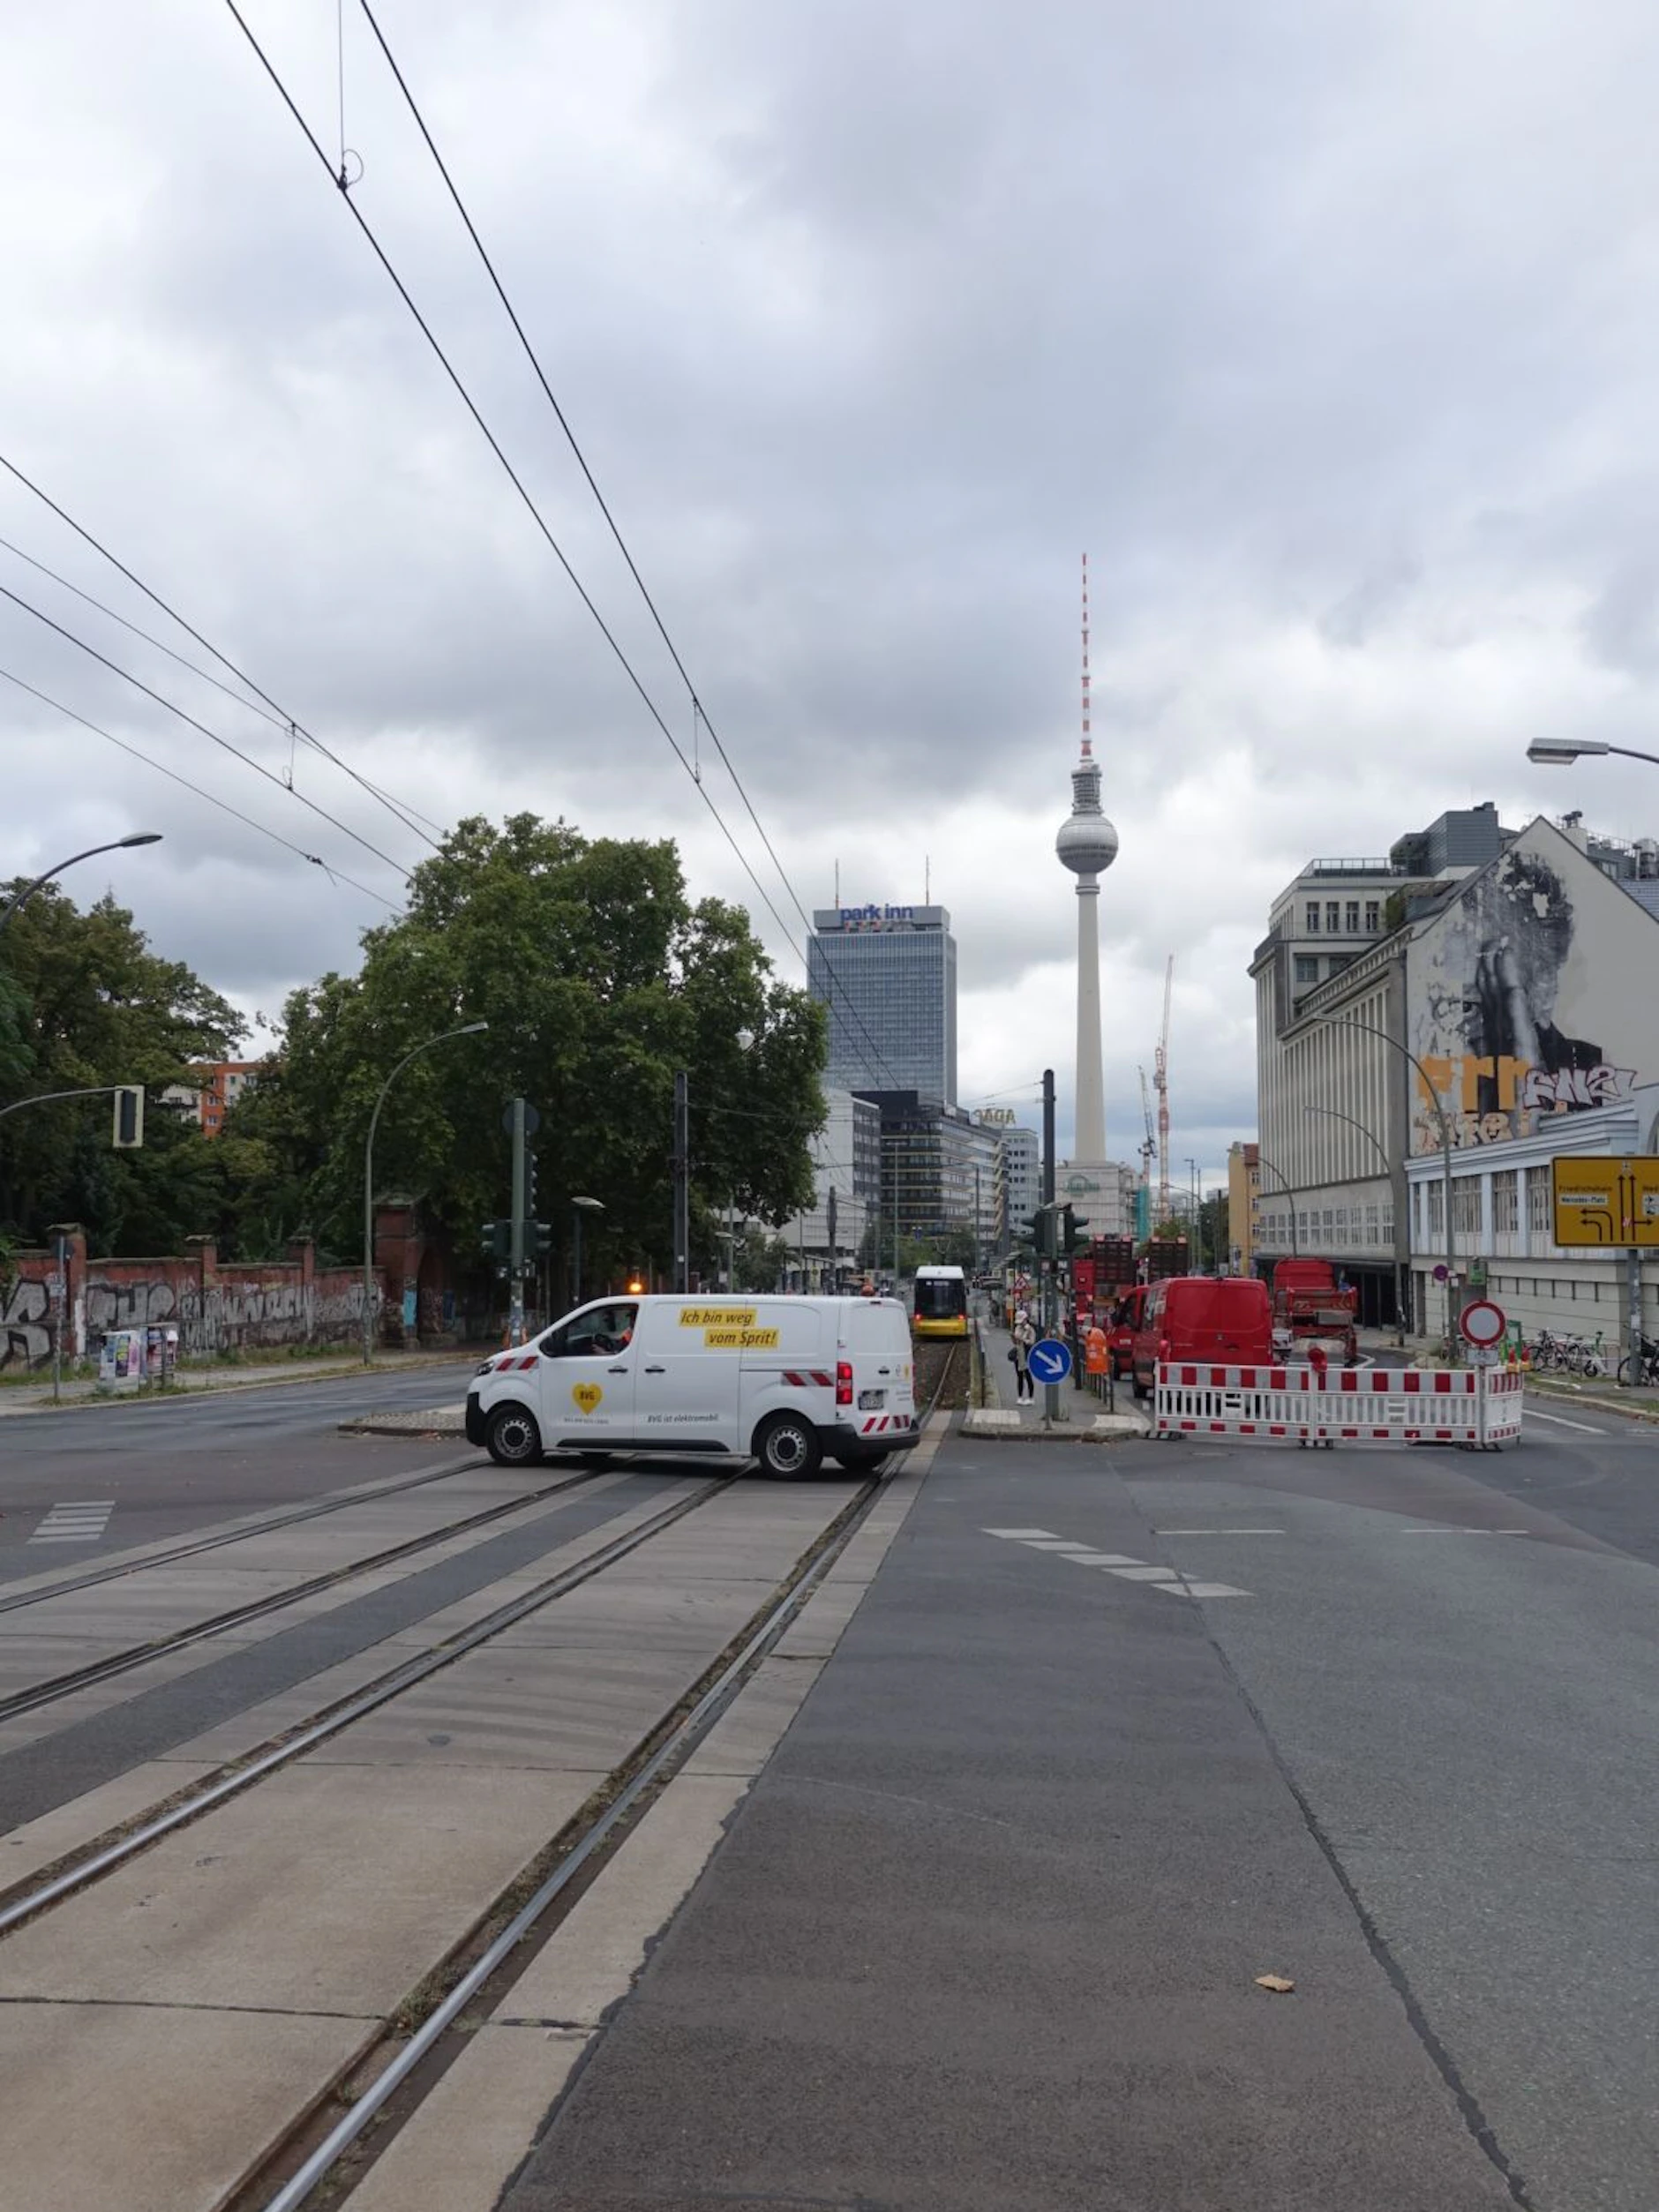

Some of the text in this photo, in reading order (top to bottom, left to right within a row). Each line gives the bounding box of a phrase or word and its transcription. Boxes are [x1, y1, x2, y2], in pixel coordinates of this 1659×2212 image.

[840, 904, 912, 924] park inn
[680, 1309, 753, 1327] Ich bin weg
[709, 1331, 777, 1347] vom Sprit!
